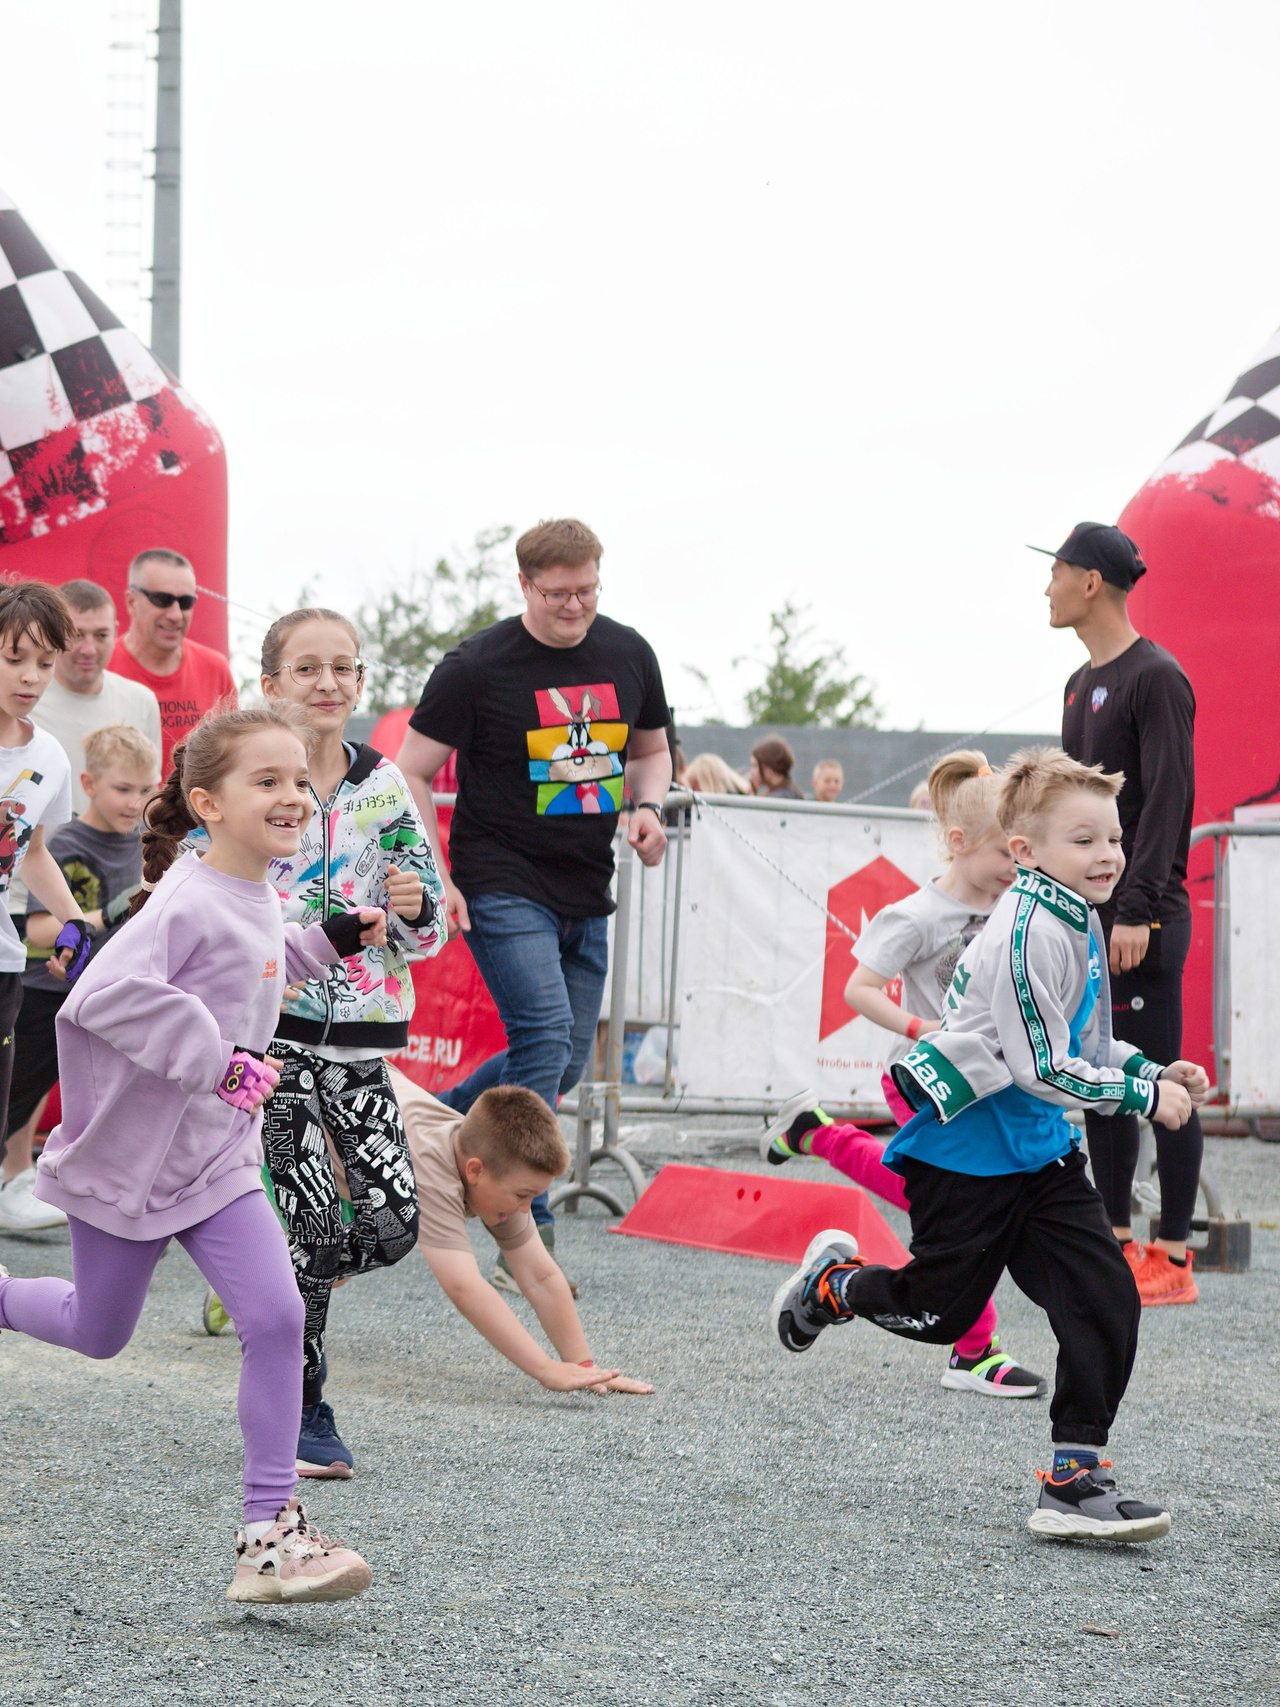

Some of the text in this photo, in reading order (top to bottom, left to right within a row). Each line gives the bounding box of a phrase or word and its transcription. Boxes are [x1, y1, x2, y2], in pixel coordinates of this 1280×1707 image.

[158, 700, 200, 714] TIONAL
[1029, 1019, 1045, 1053] adidas
[392, 1034, 462, 1067] CE.RU
[817, 1057, 851, 1069] Чтобы
[903, 1051, 952, 1102] das
[288, 1234, 342, 1246] CALIFORNI
